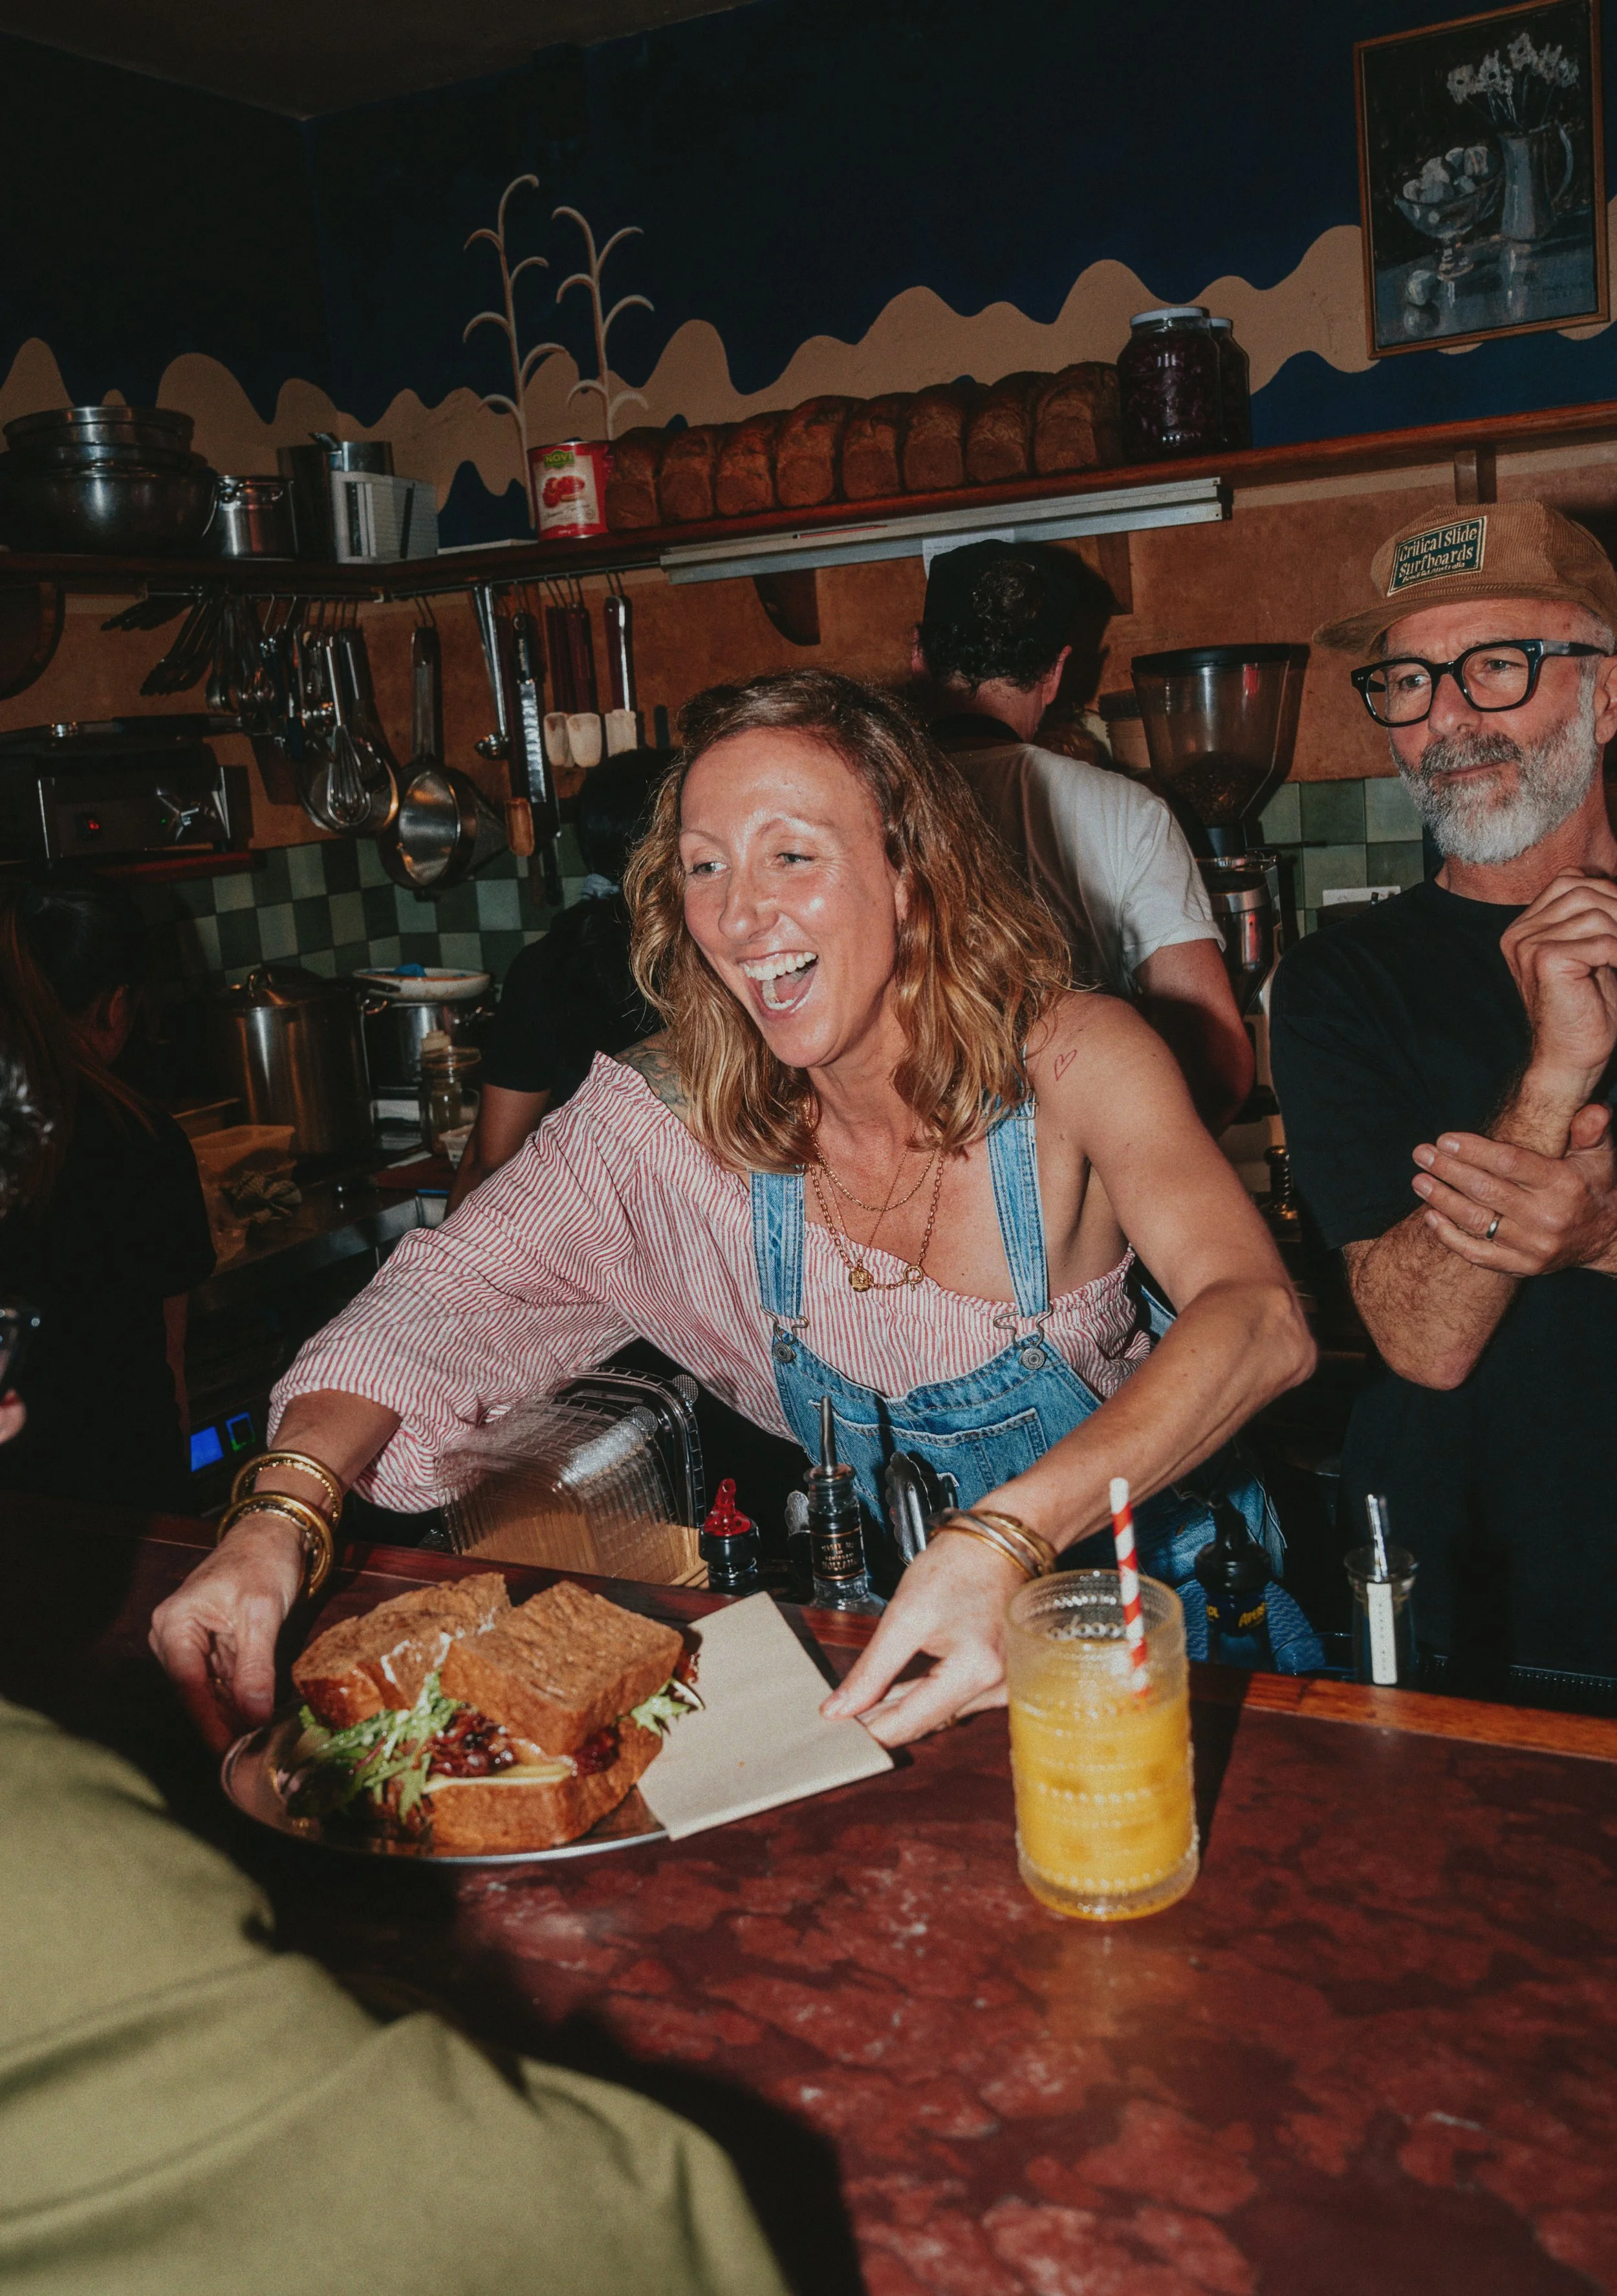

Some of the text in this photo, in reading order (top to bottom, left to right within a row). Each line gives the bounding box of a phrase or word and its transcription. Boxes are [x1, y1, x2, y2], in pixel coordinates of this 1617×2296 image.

[1398, 544, 1473, 578] Surfboards
[1399, 525, 1477, 562] Critical Slide
